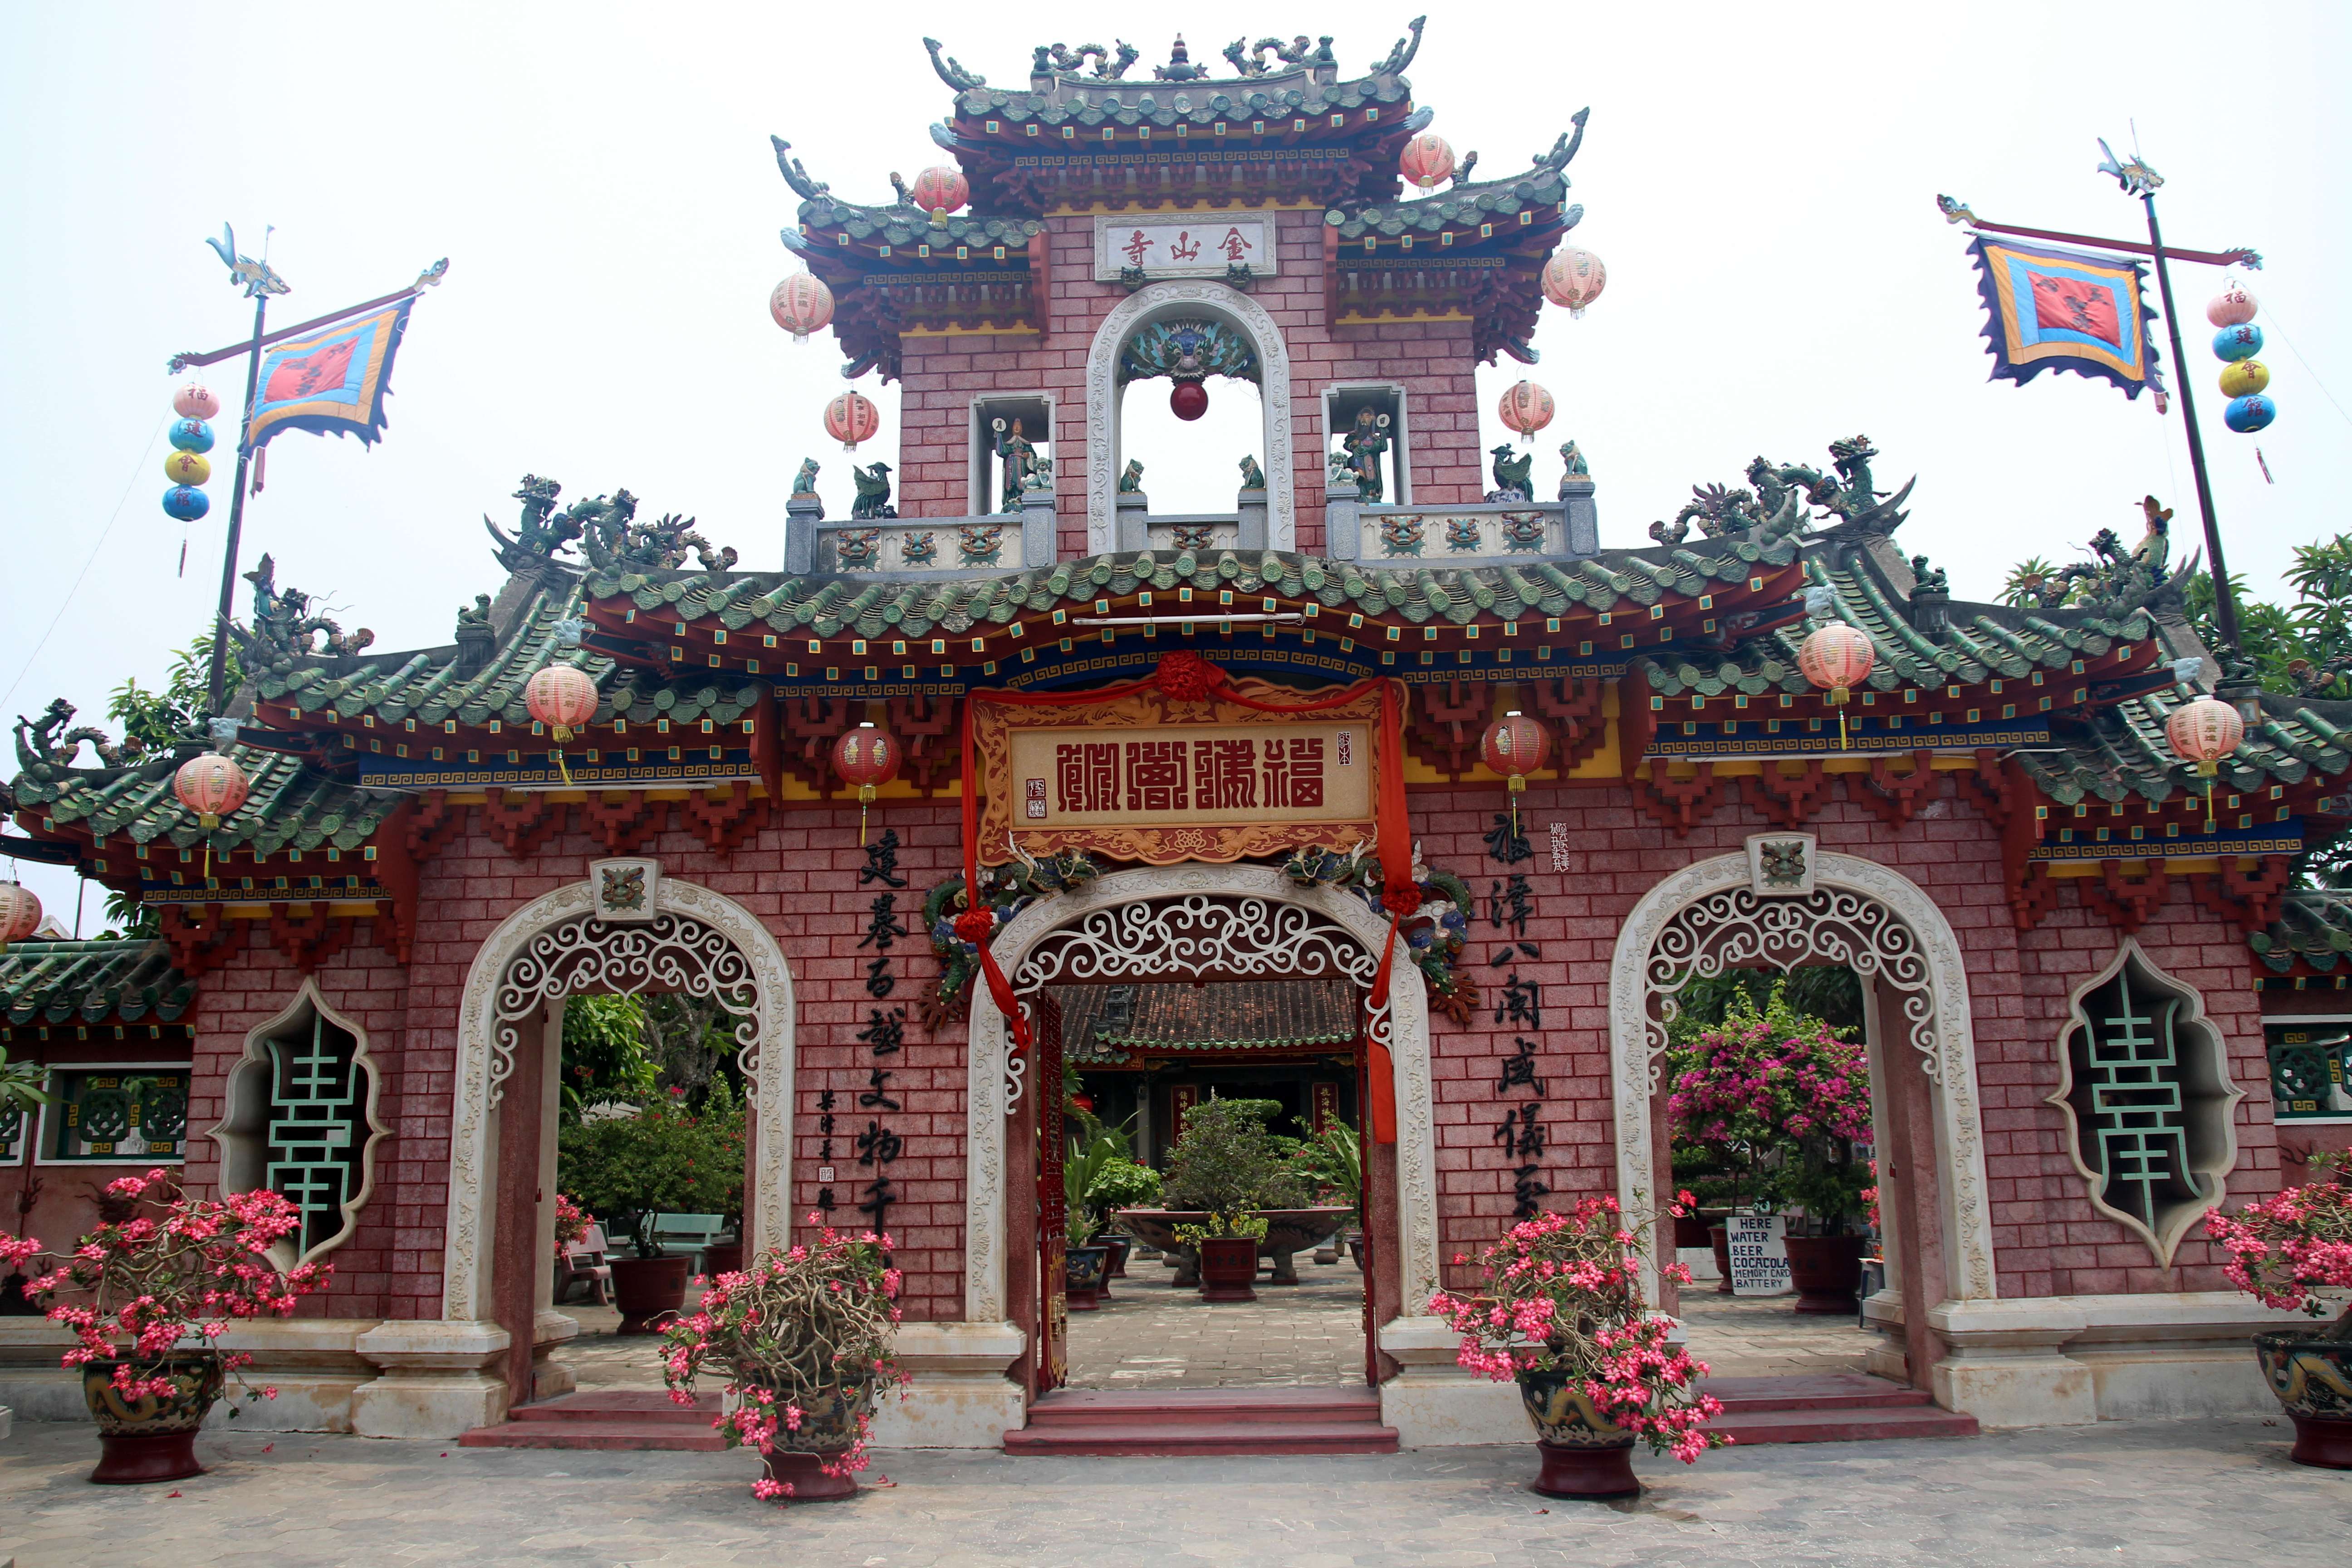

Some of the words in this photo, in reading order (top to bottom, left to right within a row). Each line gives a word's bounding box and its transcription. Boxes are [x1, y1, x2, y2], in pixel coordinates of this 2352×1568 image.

[1122, 227, 1252, 266] 金山寺
[2224, 291, 2264, 416] 福建會館
[995, 420, 1002, 430] 月
[172, 387, 208, 506] 福建會館
[1740, 1218, 1772, 1229] HERE
[1771, 1269, 1791, 1278] CARD
